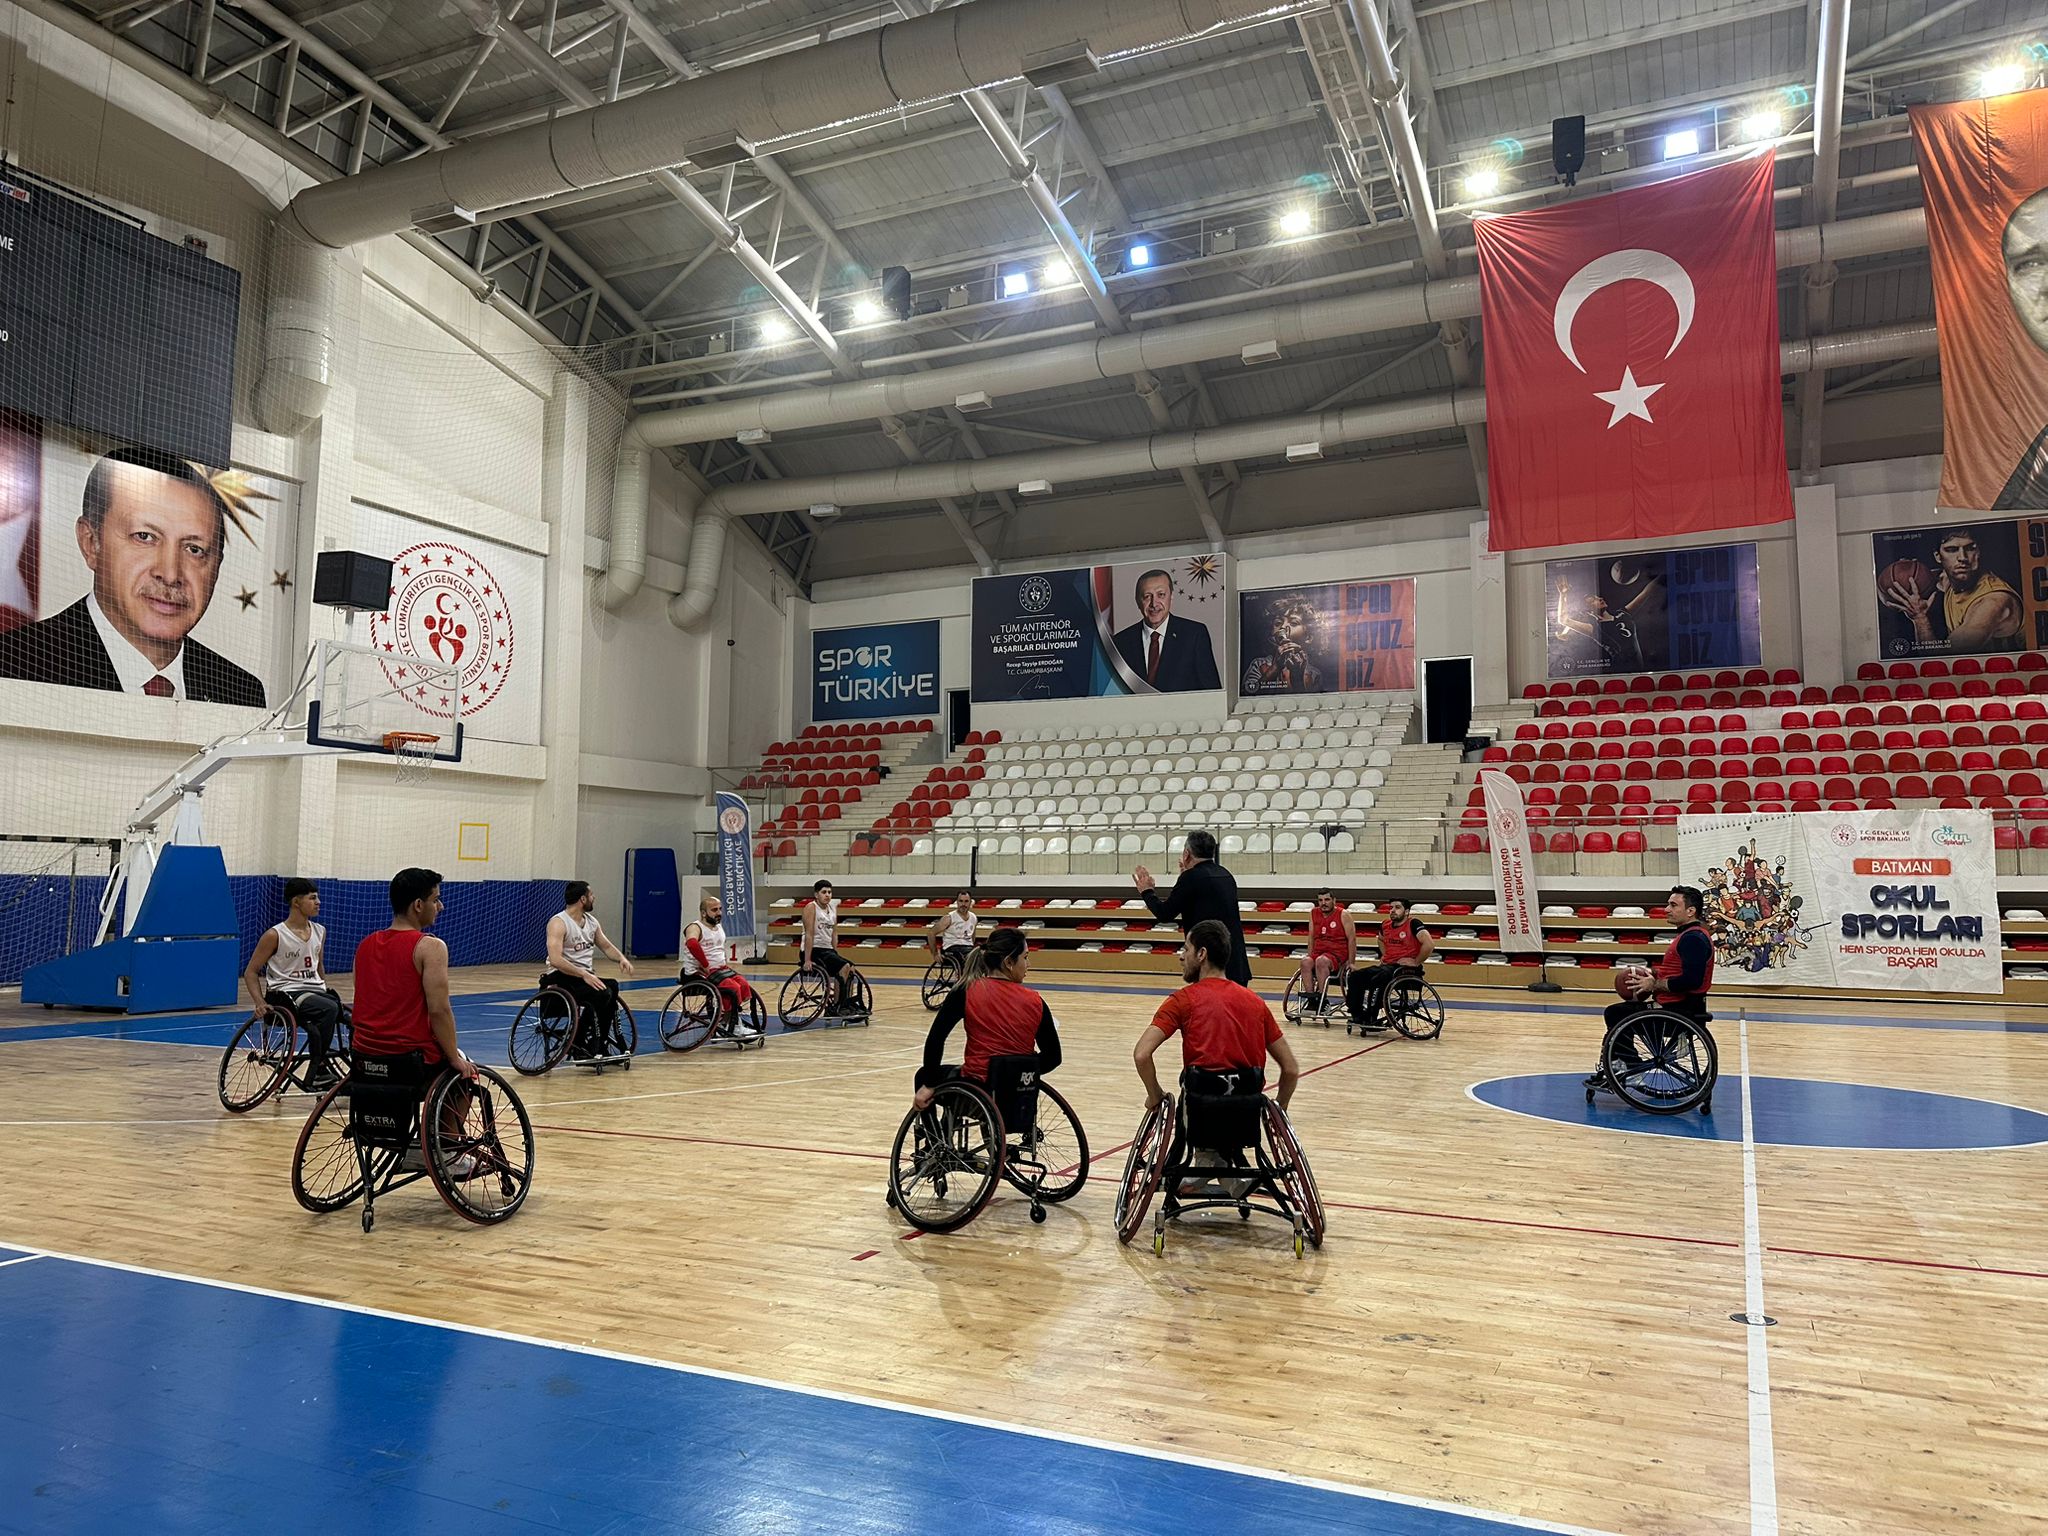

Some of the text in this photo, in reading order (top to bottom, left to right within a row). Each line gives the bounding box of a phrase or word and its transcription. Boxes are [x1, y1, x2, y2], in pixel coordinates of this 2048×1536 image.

[434, 574, 472, 598] GENÇLİK
[399, 574, 434, 639] CUMHURİYETİ
[471, 596, 482, 610] VE
[1346, 583, 1392, 615] SPOR
[478, 611, 490, 641] SPOR
[1000, 620, 1071, 633] TÜM ANTRENÖR
[1615, 622, 1631, 638] 3
[990, 629, 1081, 644] VE SPORCULARIMIZA
[993, 640, 1078, 654] BAŞARILAR DİLİYORUM
[462, 643, 490, 685] BAKANLI
[818, 644, 892, 672] SPOR
[1346, 654, 1375, 689] BİZ
[818, 671, 934, 703] TÜRKİYE
[1872, 829, 1901, 837] GENÇLİK
[1871, 861, 1932, 873] BATMAN
[1870, 884, 1950, 910] OKUL
[1841, 912, 1984, 941] SPORLARI
[729, 943, 738, 961] 1
[1839, 945, 1986, 958] HEM SPORDA HEM OKULDA
[304, 956, 312, 968] 8
[1887, 957, 1938, 969] BAŞARI
[364, 1115, 396, 1125] EXTRA
